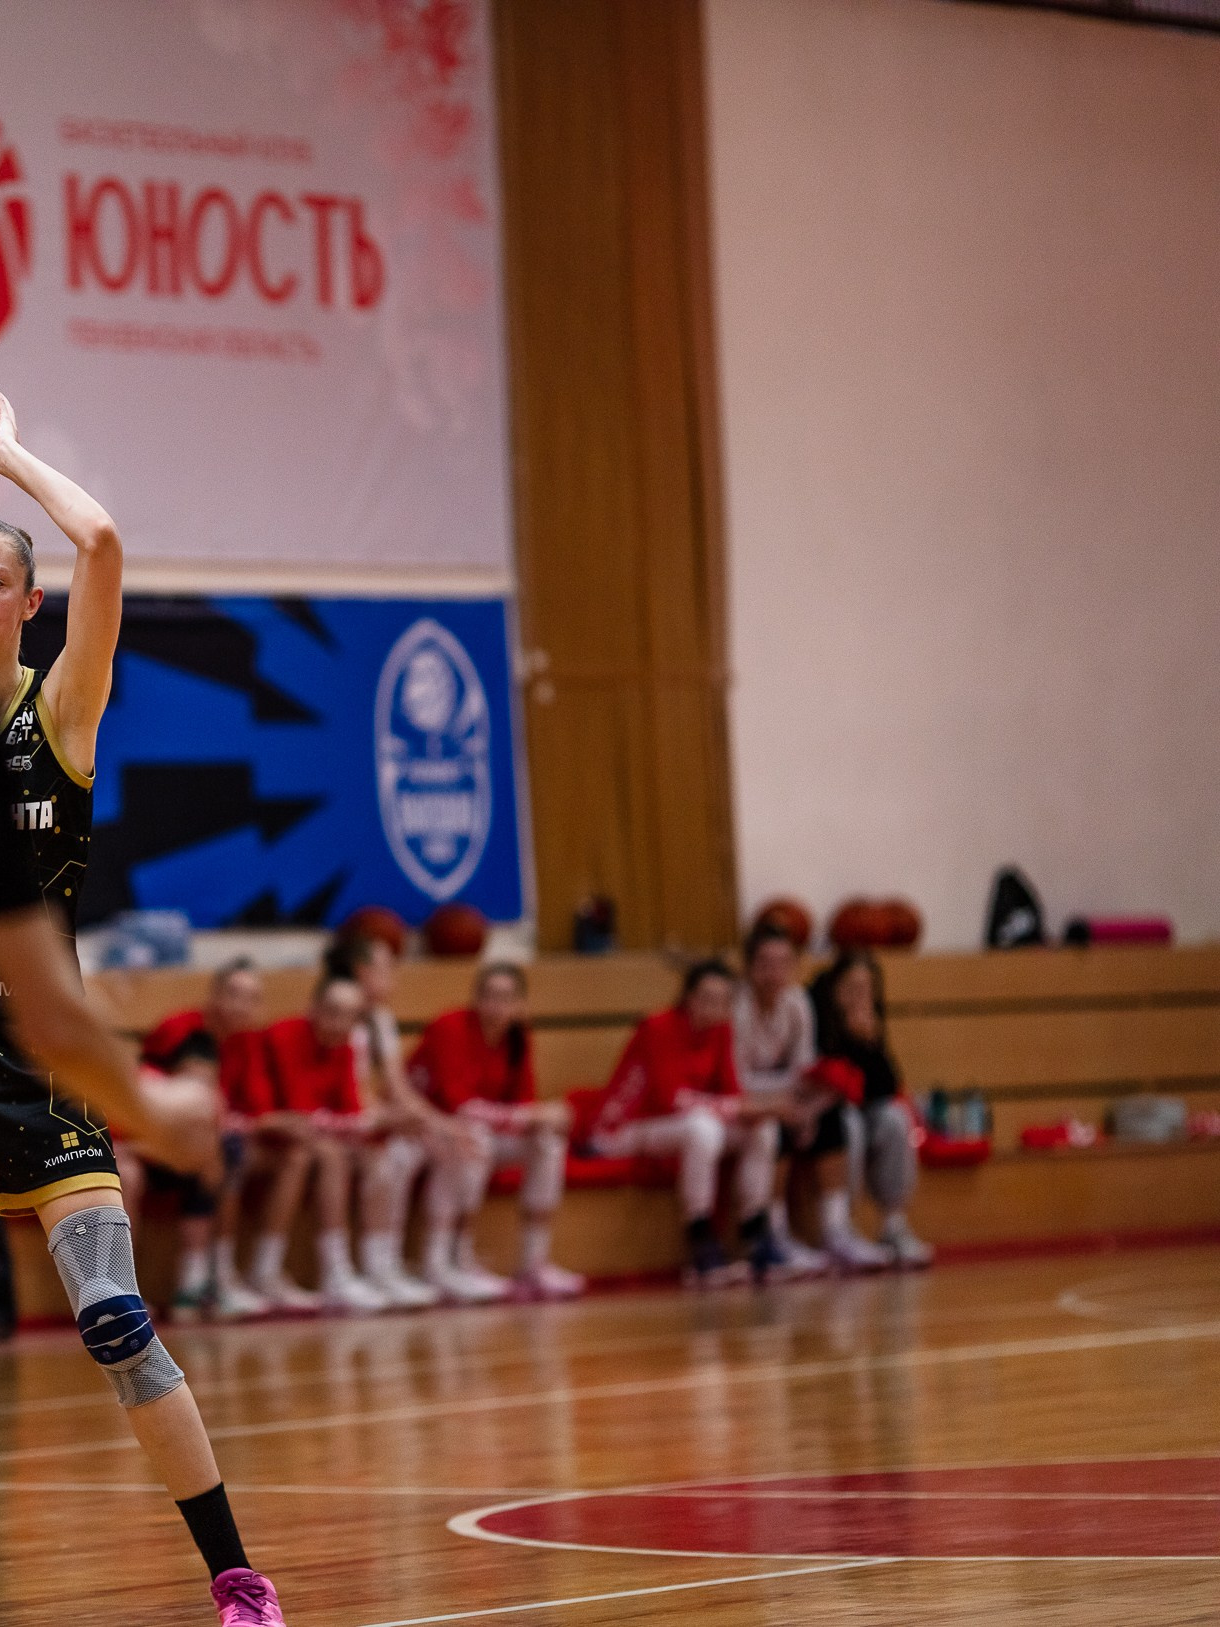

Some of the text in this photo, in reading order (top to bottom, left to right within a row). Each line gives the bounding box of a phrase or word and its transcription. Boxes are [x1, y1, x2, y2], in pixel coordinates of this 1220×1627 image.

[63, 171, 386, 310] ЮНОСТЬ
[11, 710, 34, 731] FN
[10, 800, 53, 831] НТА
[44, 1148, 103, 1168] ХИМПРОМ
